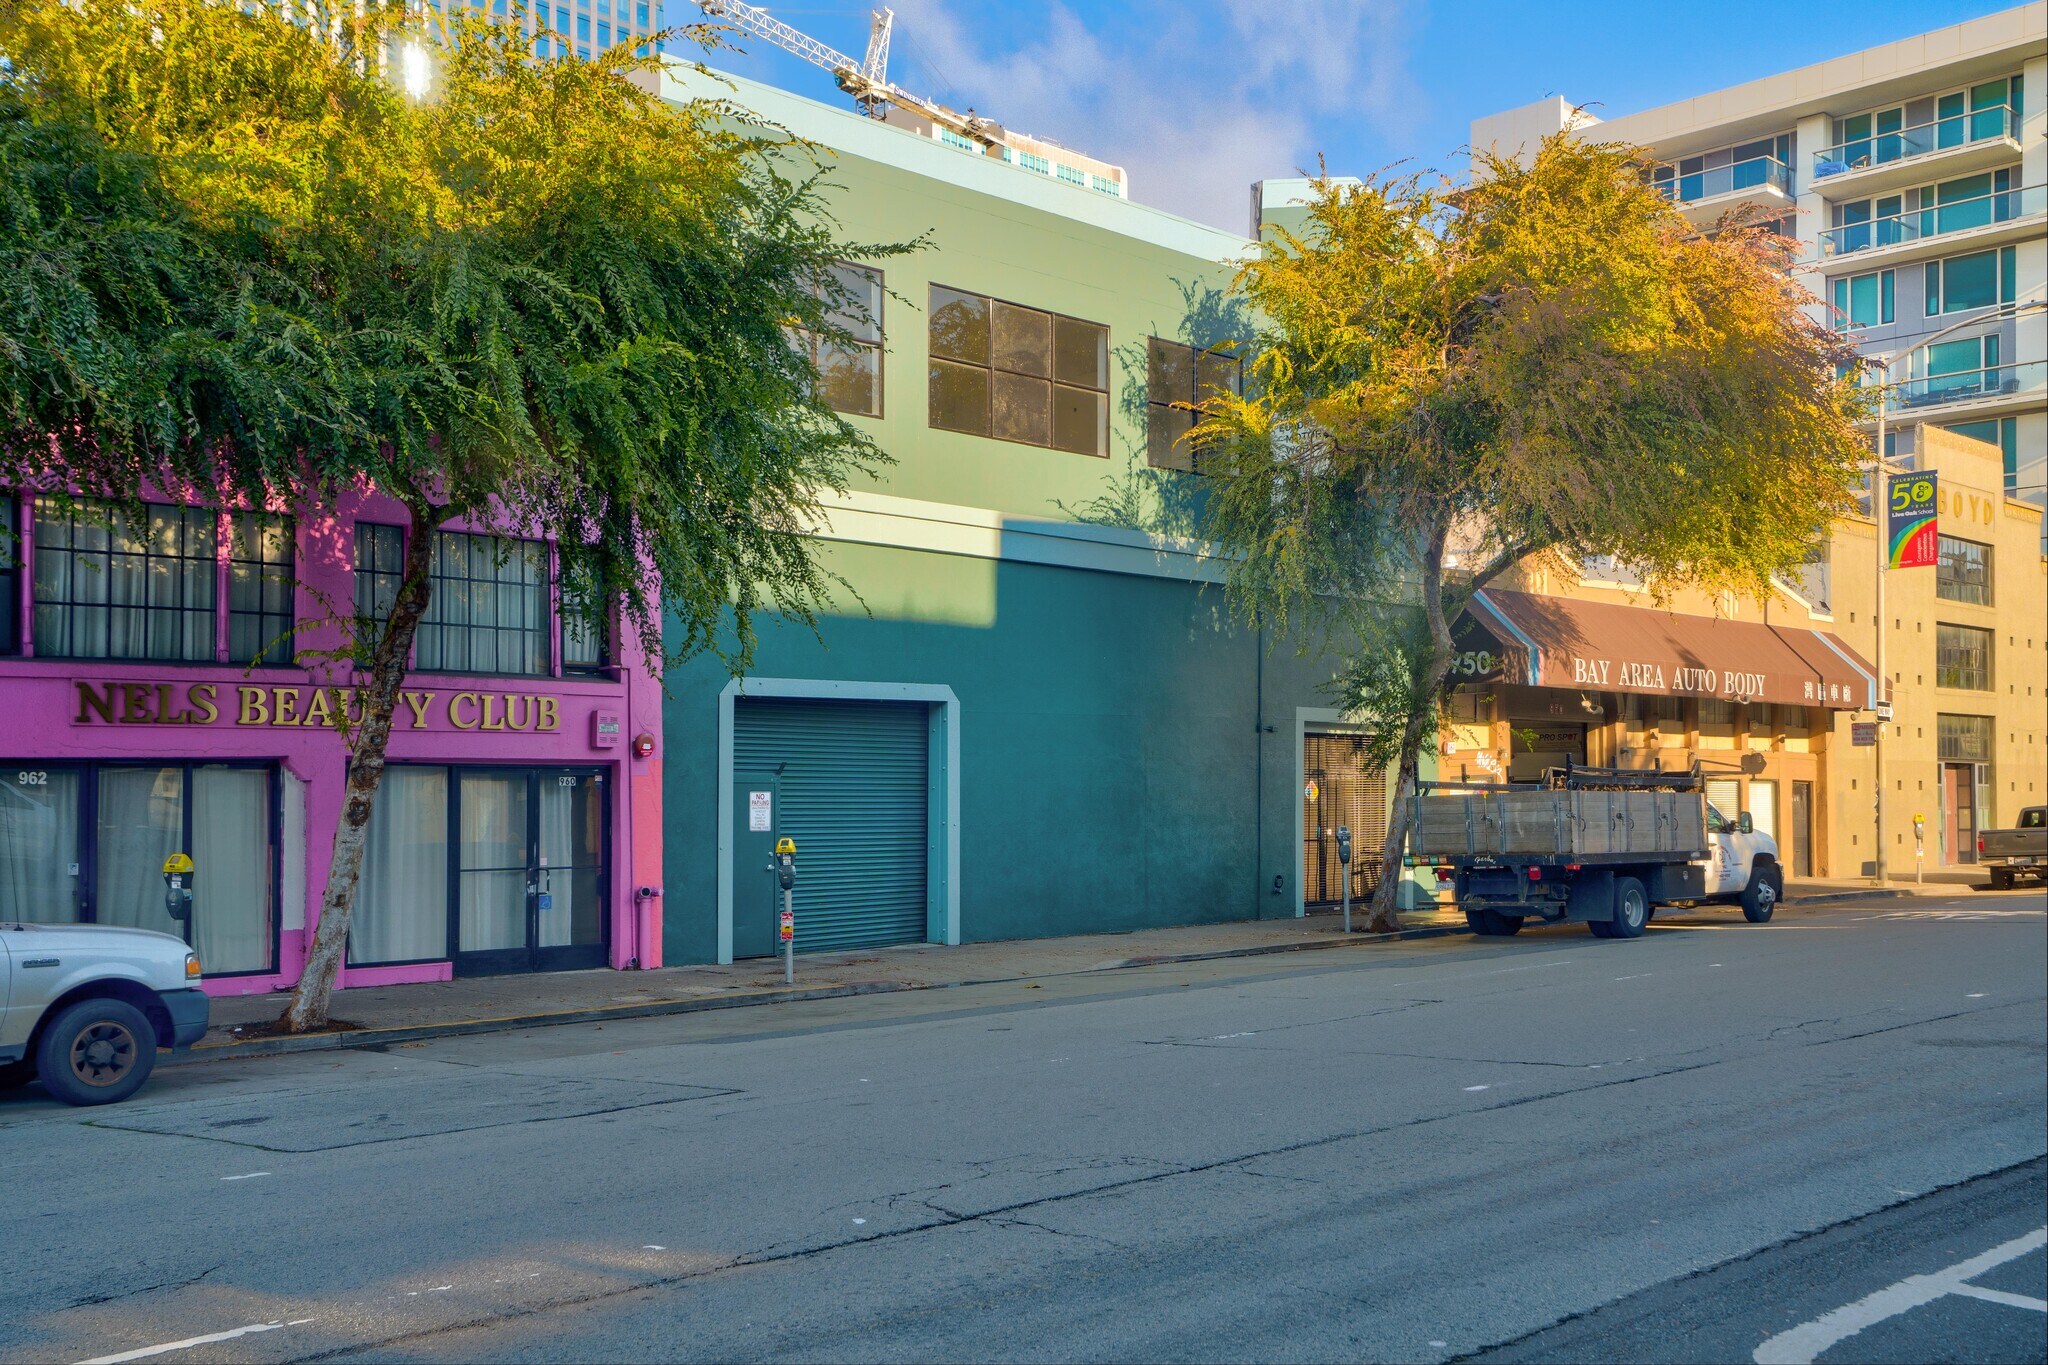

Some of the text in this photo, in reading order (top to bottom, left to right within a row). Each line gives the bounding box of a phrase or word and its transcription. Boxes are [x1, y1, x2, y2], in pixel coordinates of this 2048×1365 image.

[894, 86, 926, 106] SWINERTON
[1891, 474, 1934, 484] CELEBRATING
[1891, 482, 1934, 511] 50
[1938, 485, 1993, 526] BOYD
[1573, 658, 1766, 696] BAY AREA AUTO BODY
[74, 681, 561, 731] NELS BEAUY CLUB
[1539, 733, 1578, 741] PRO SPOT
[19, 771, 47, 785] 962
[559, 777, 576, 786] 960
